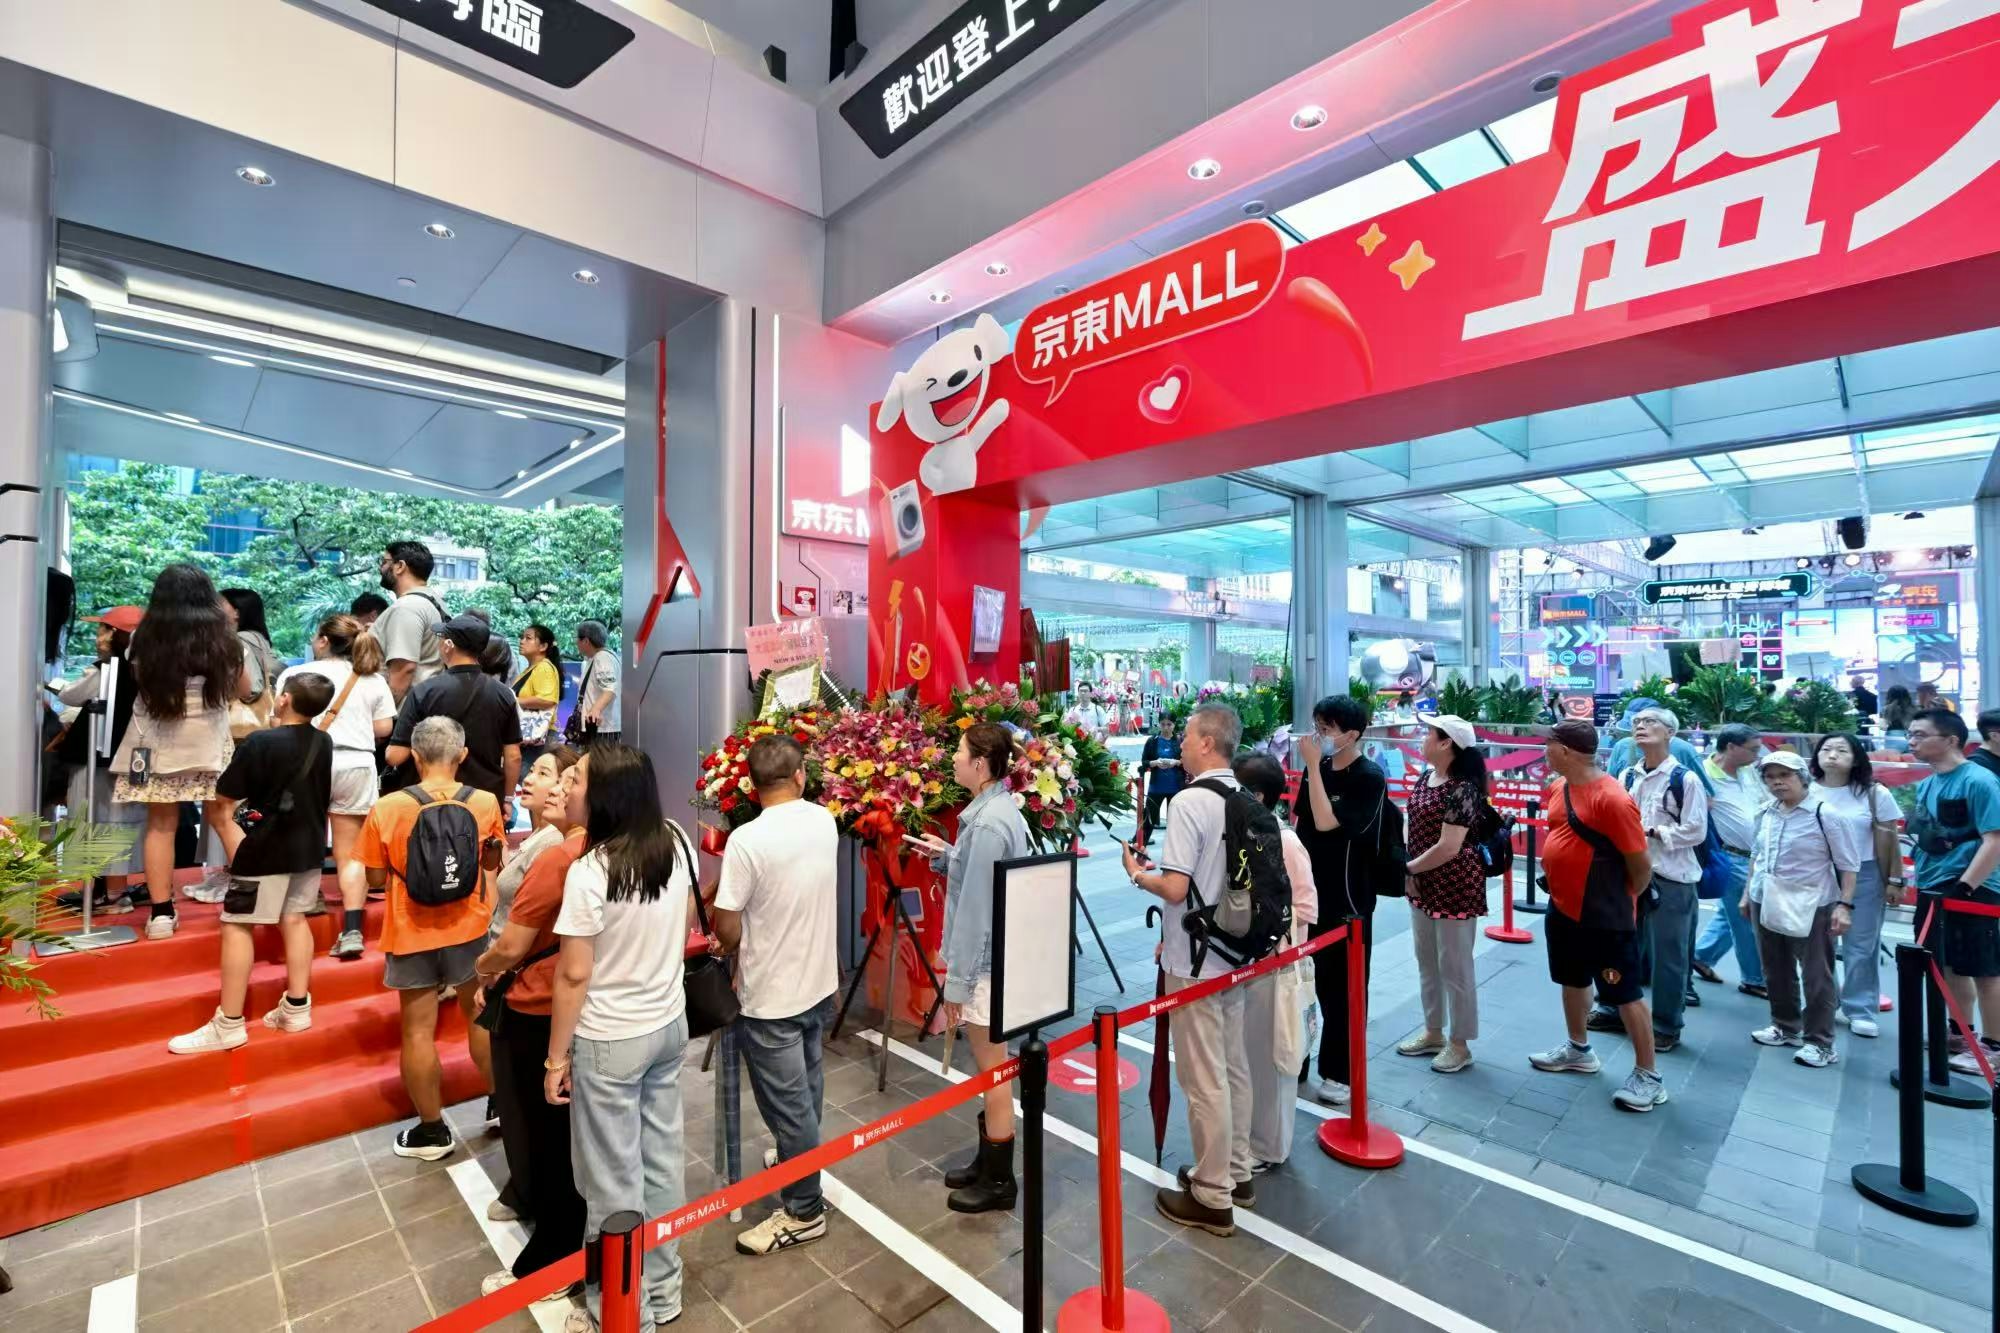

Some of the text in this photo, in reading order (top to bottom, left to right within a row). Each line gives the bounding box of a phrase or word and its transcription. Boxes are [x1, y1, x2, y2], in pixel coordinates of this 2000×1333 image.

[416, 0, 543, 55] 臨
[882, 0, 1061, 134] 歡迎登上
[1032, 249, 1258, 369] 京東MALL
[674, 1197, 728, 1230] 京东MALL
